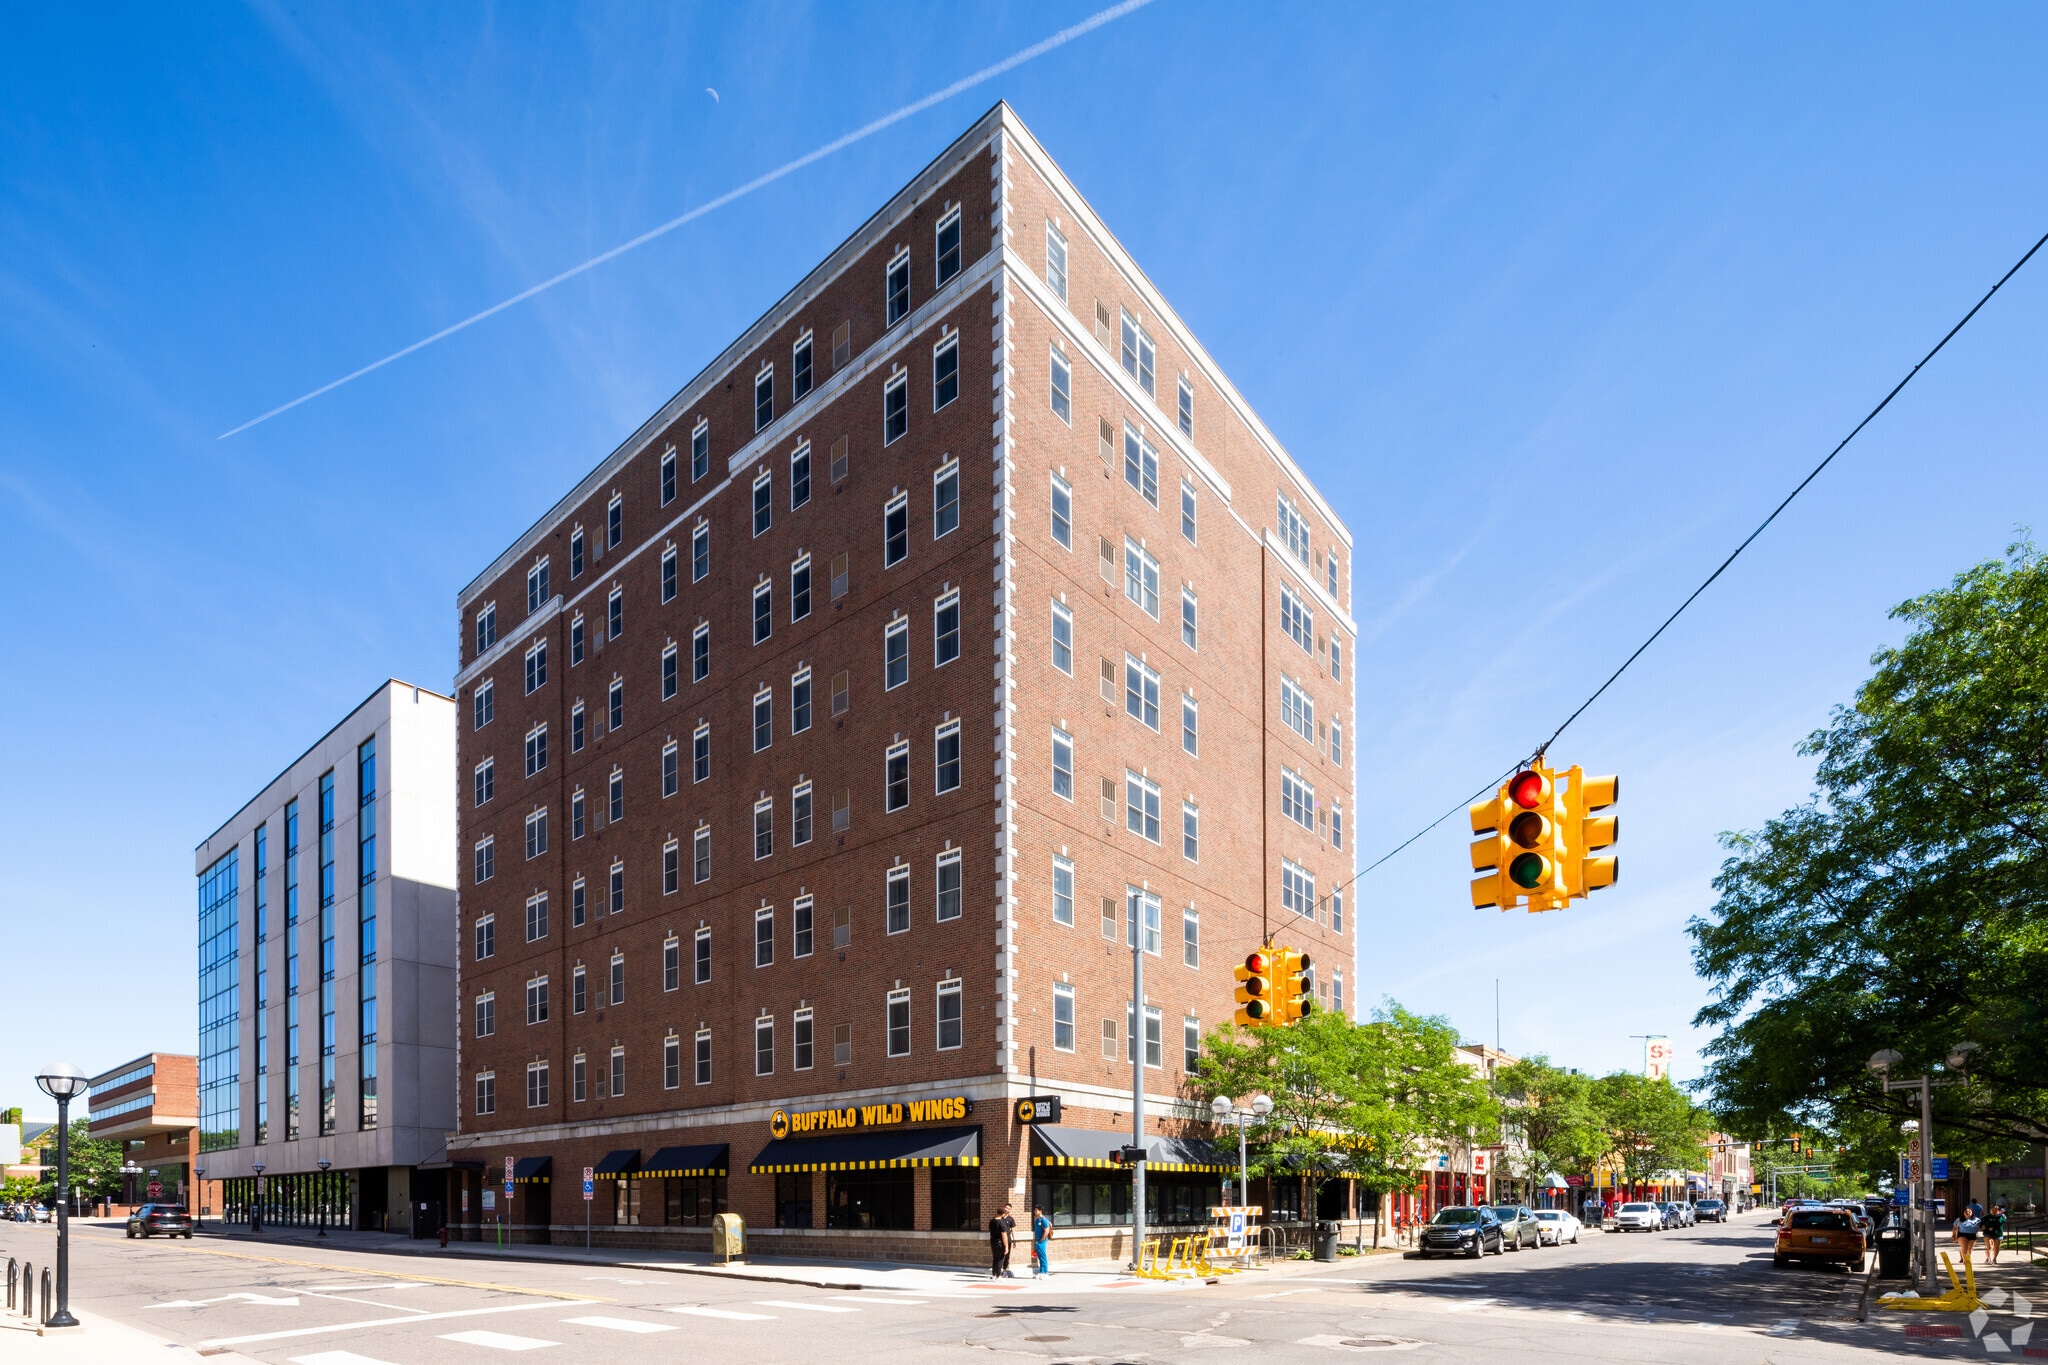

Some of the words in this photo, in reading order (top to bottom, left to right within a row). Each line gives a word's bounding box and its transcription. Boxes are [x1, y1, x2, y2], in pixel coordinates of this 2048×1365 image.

[792, 1107, 857, 1132] BUFFALO
[861, 1103, 903, 1126] WILD
[908, 1096, 966, 1122] WINGS
[1234, 1216, 1241, 1230] P
